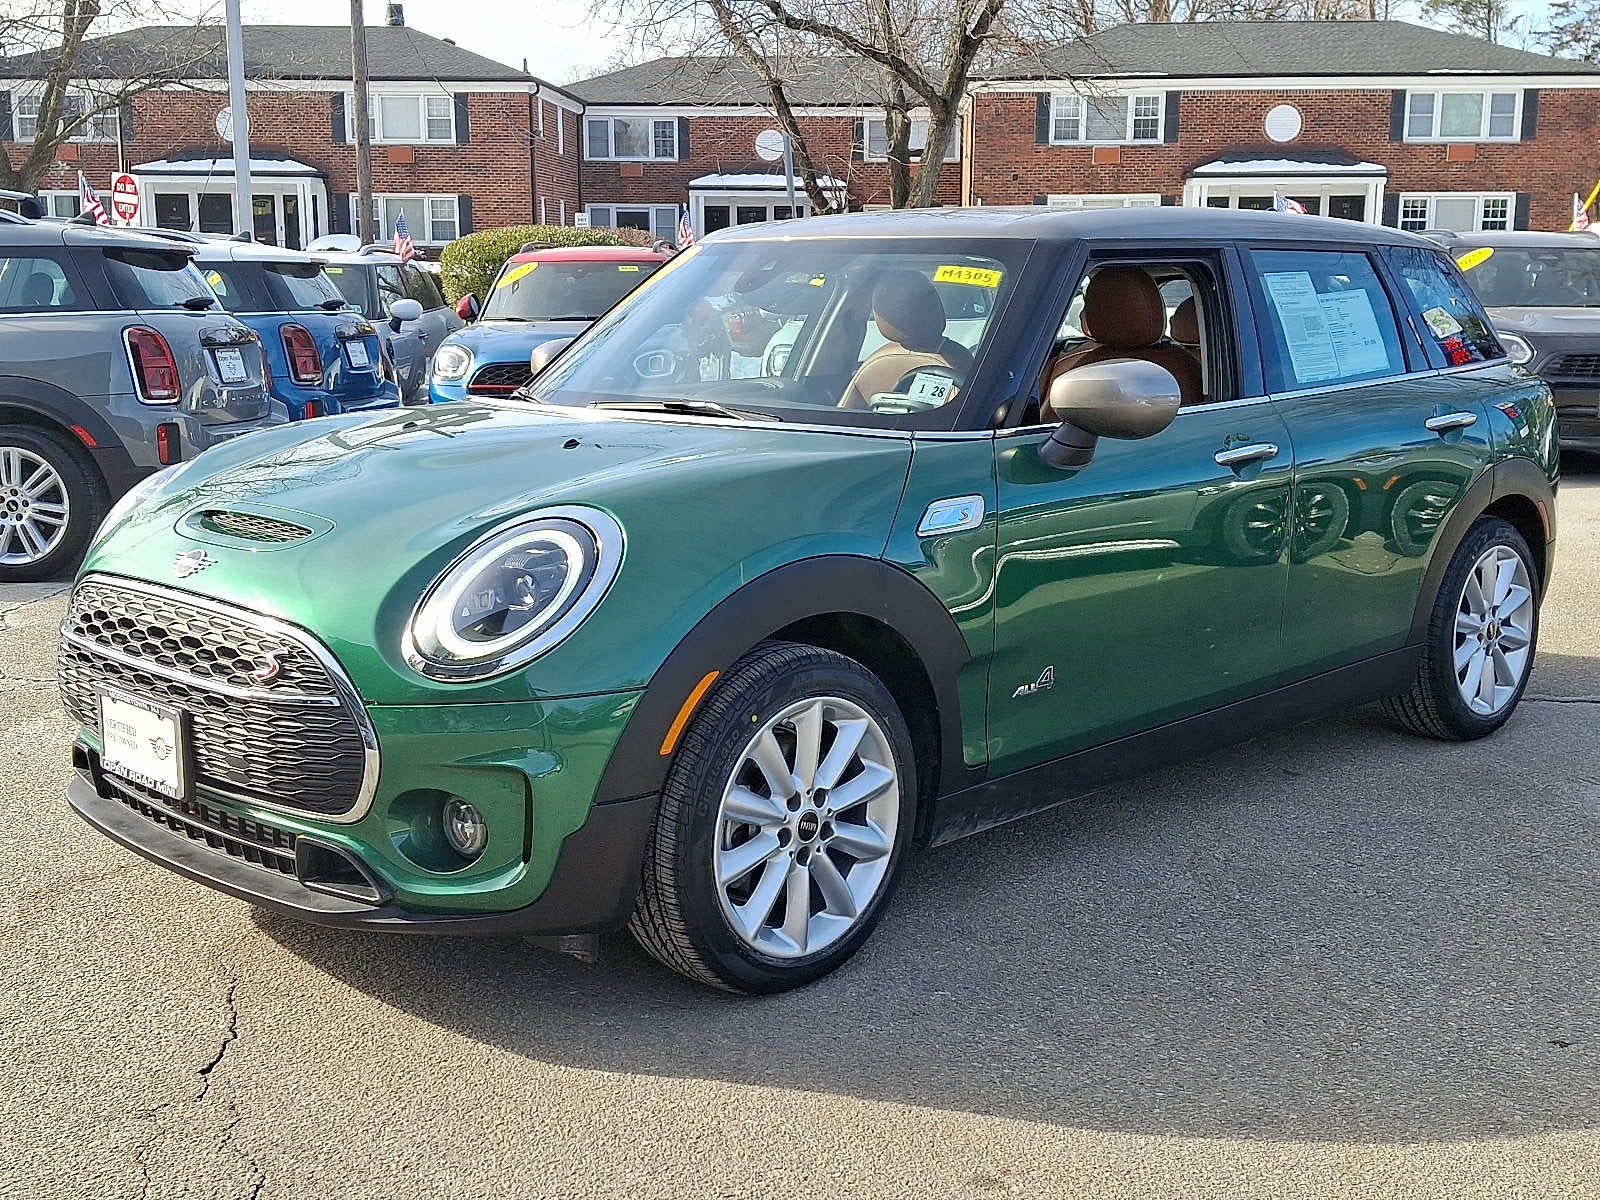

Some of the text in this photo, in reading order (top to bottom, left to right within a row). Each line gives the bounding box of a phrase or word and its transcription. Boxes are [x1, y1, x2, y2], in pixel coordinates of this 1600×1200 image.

[117, 183, 135, 193] DO NOT
[118, 203, 134, 213] ENTER
[942, 269, 999, 283] M4305
[919, 383, 946, 397] 1 28
[252, 648, 289, 680] S
[102, 759, 177, 798] OPEN ROAD MINI
